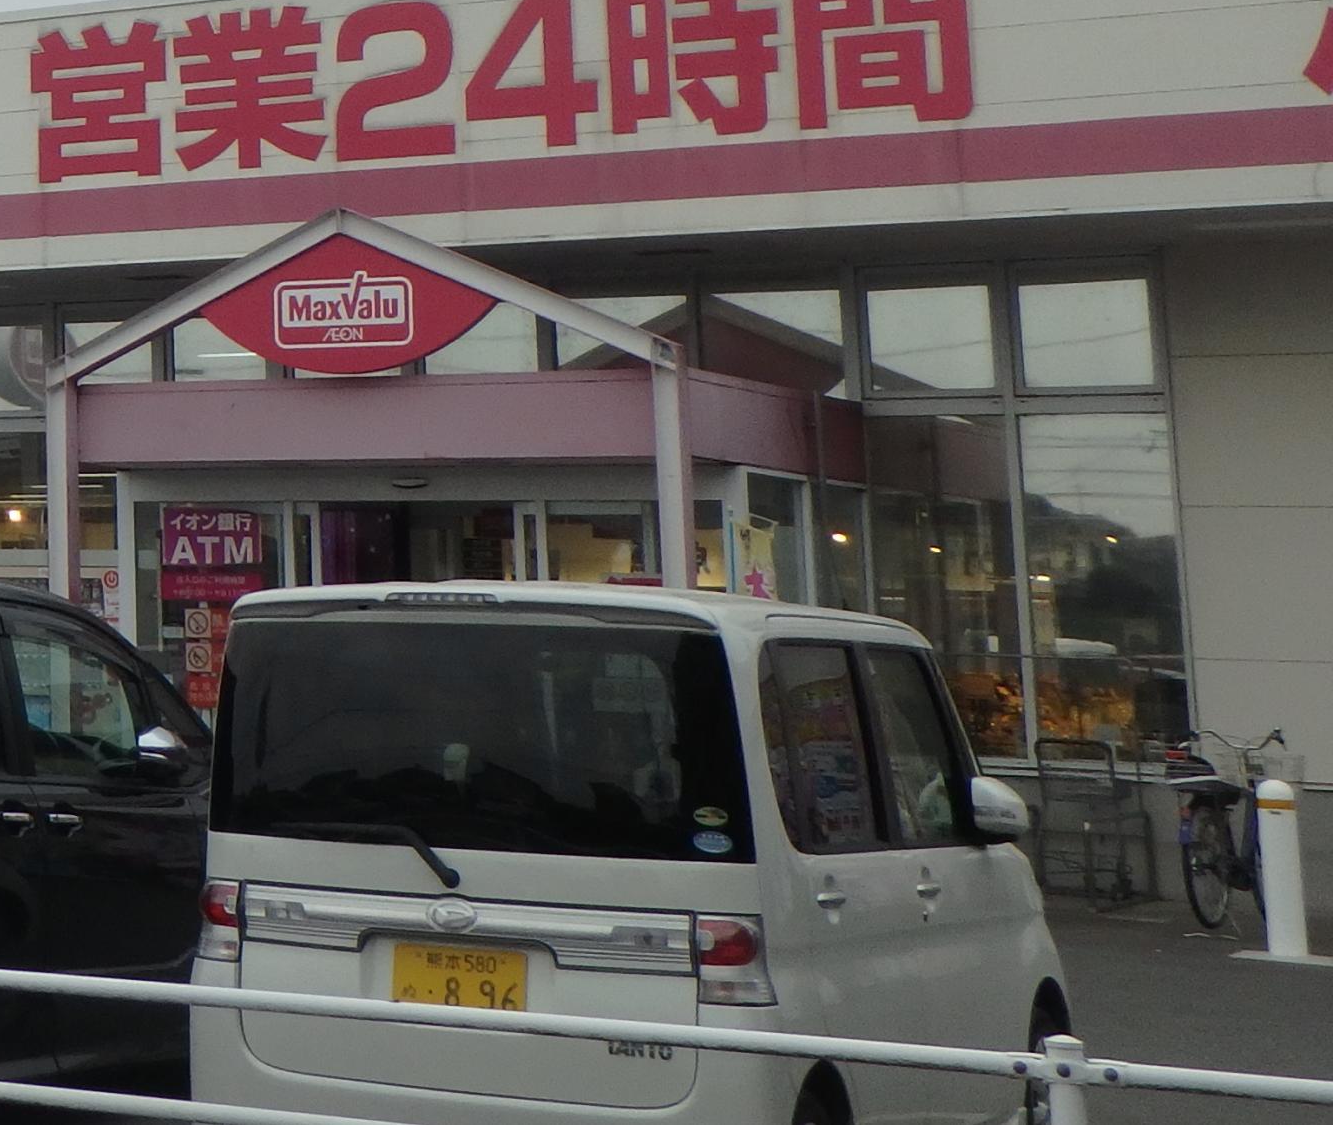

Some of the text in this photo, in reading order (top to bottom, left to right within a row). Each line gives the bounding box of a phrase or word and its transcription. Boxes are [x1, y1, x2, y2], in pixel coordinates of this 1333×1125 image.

[288, 274, 399, 322] MaxValu
[171, 513, 252, 532] イオン銀行
[170, 536, 253, 564] ATM
